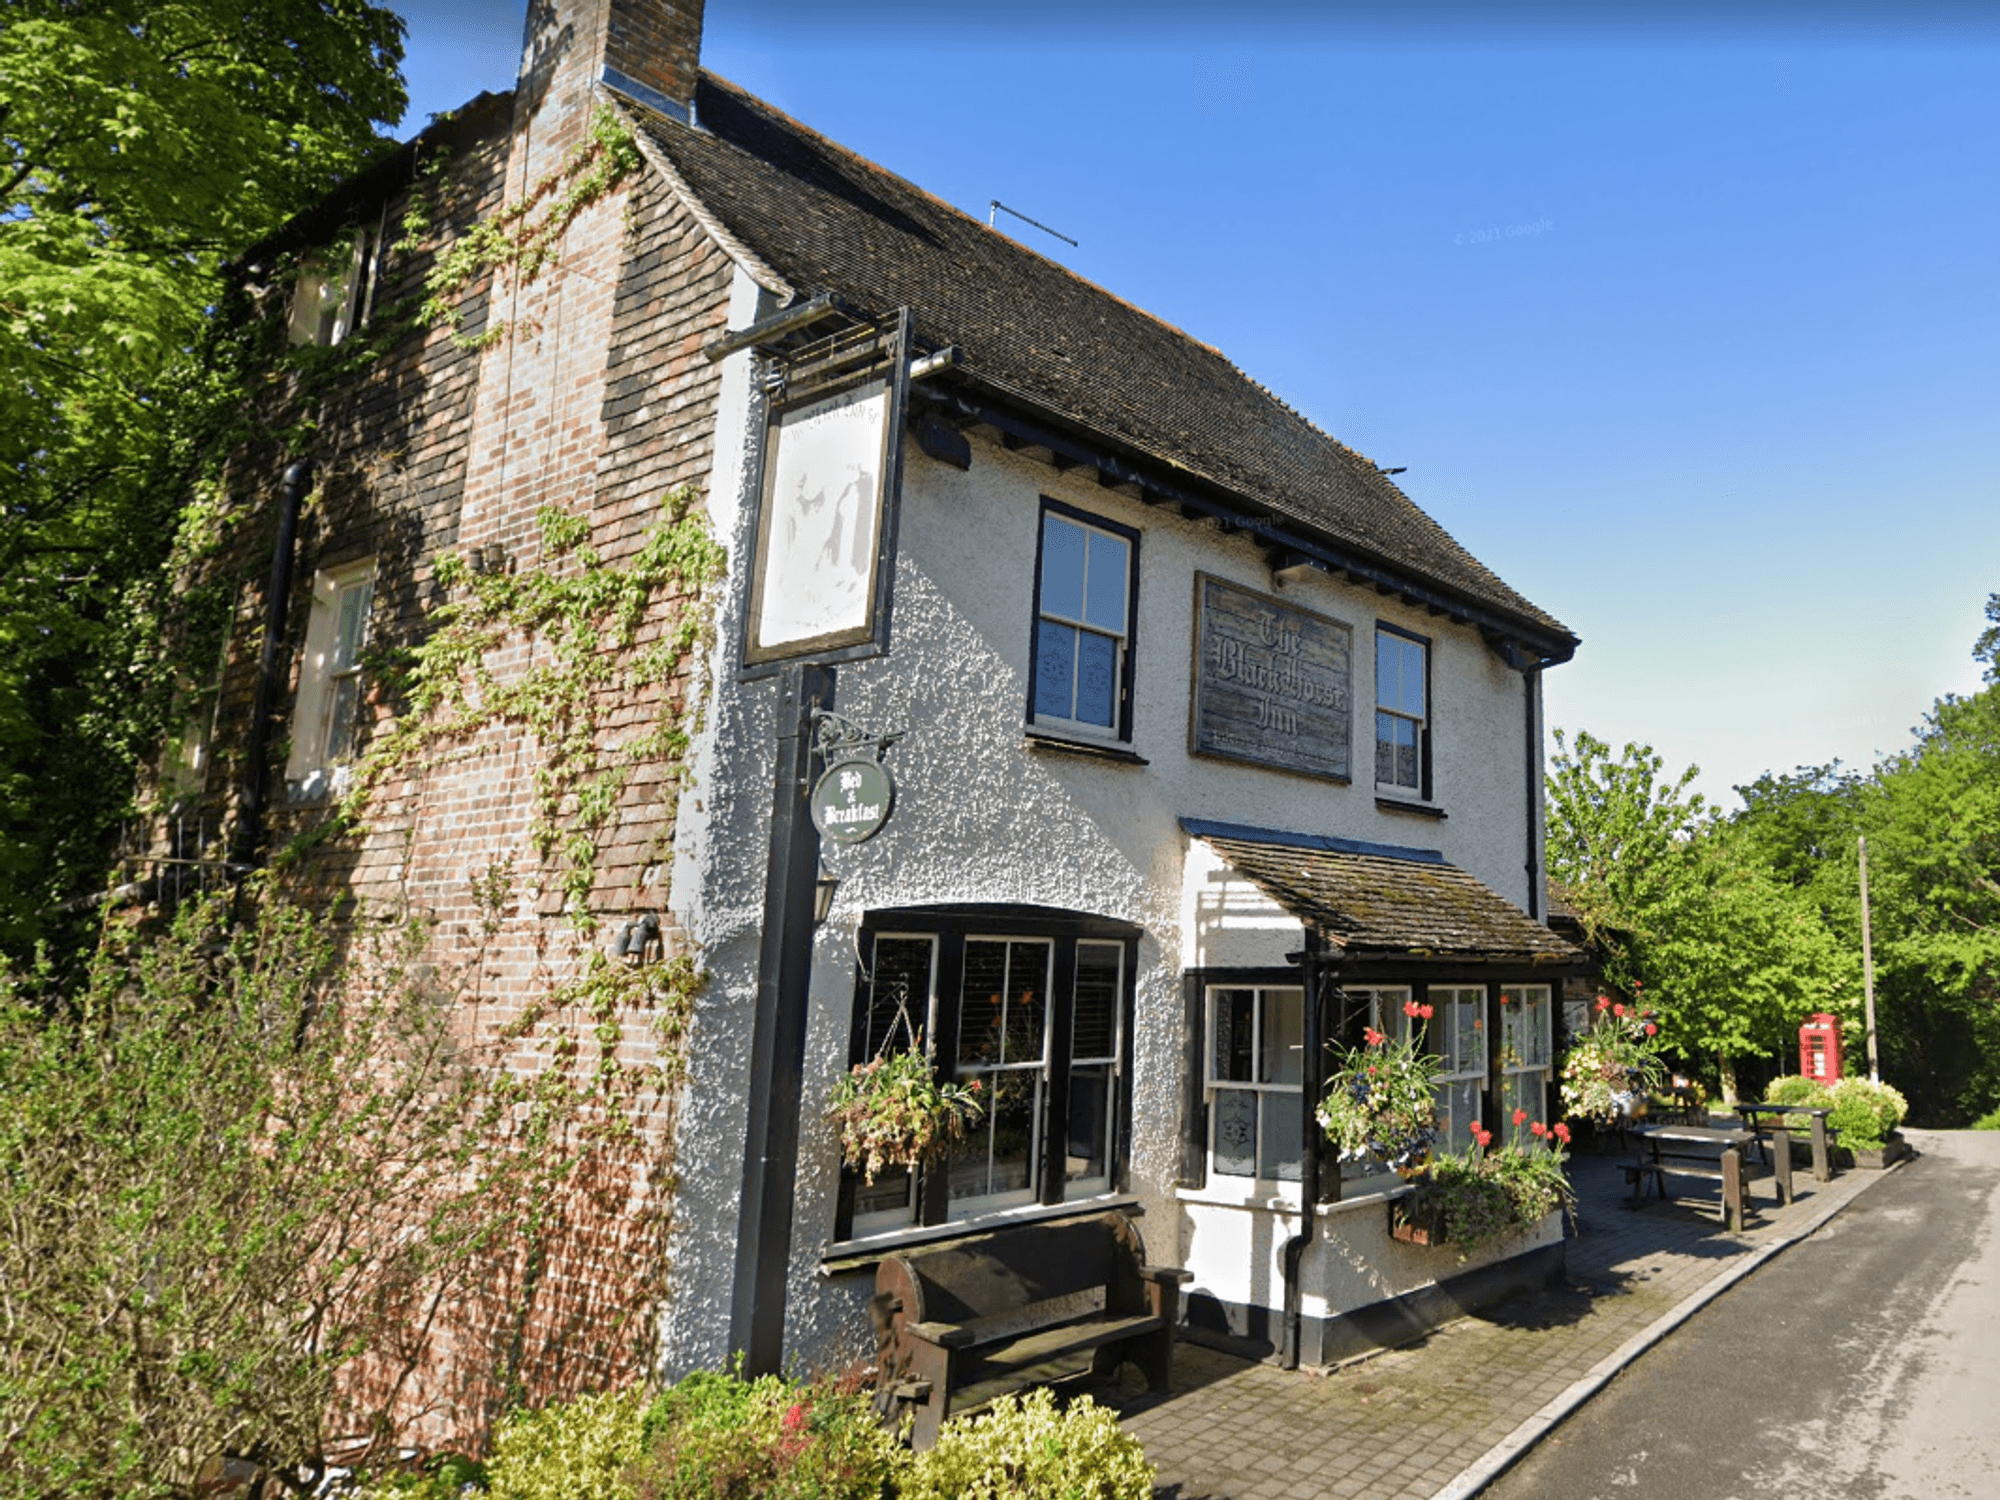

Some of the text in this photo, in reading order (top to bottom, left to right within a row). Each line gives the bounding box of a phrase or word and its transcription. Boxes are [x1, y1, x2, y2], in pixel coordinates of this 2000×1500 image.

[1258, 610, 1302, 654] The
[1252, 695, 1300, 737] Inn
[840, 771, 862, 792] Bed
[824, 802, 880, 825] Breakfast
